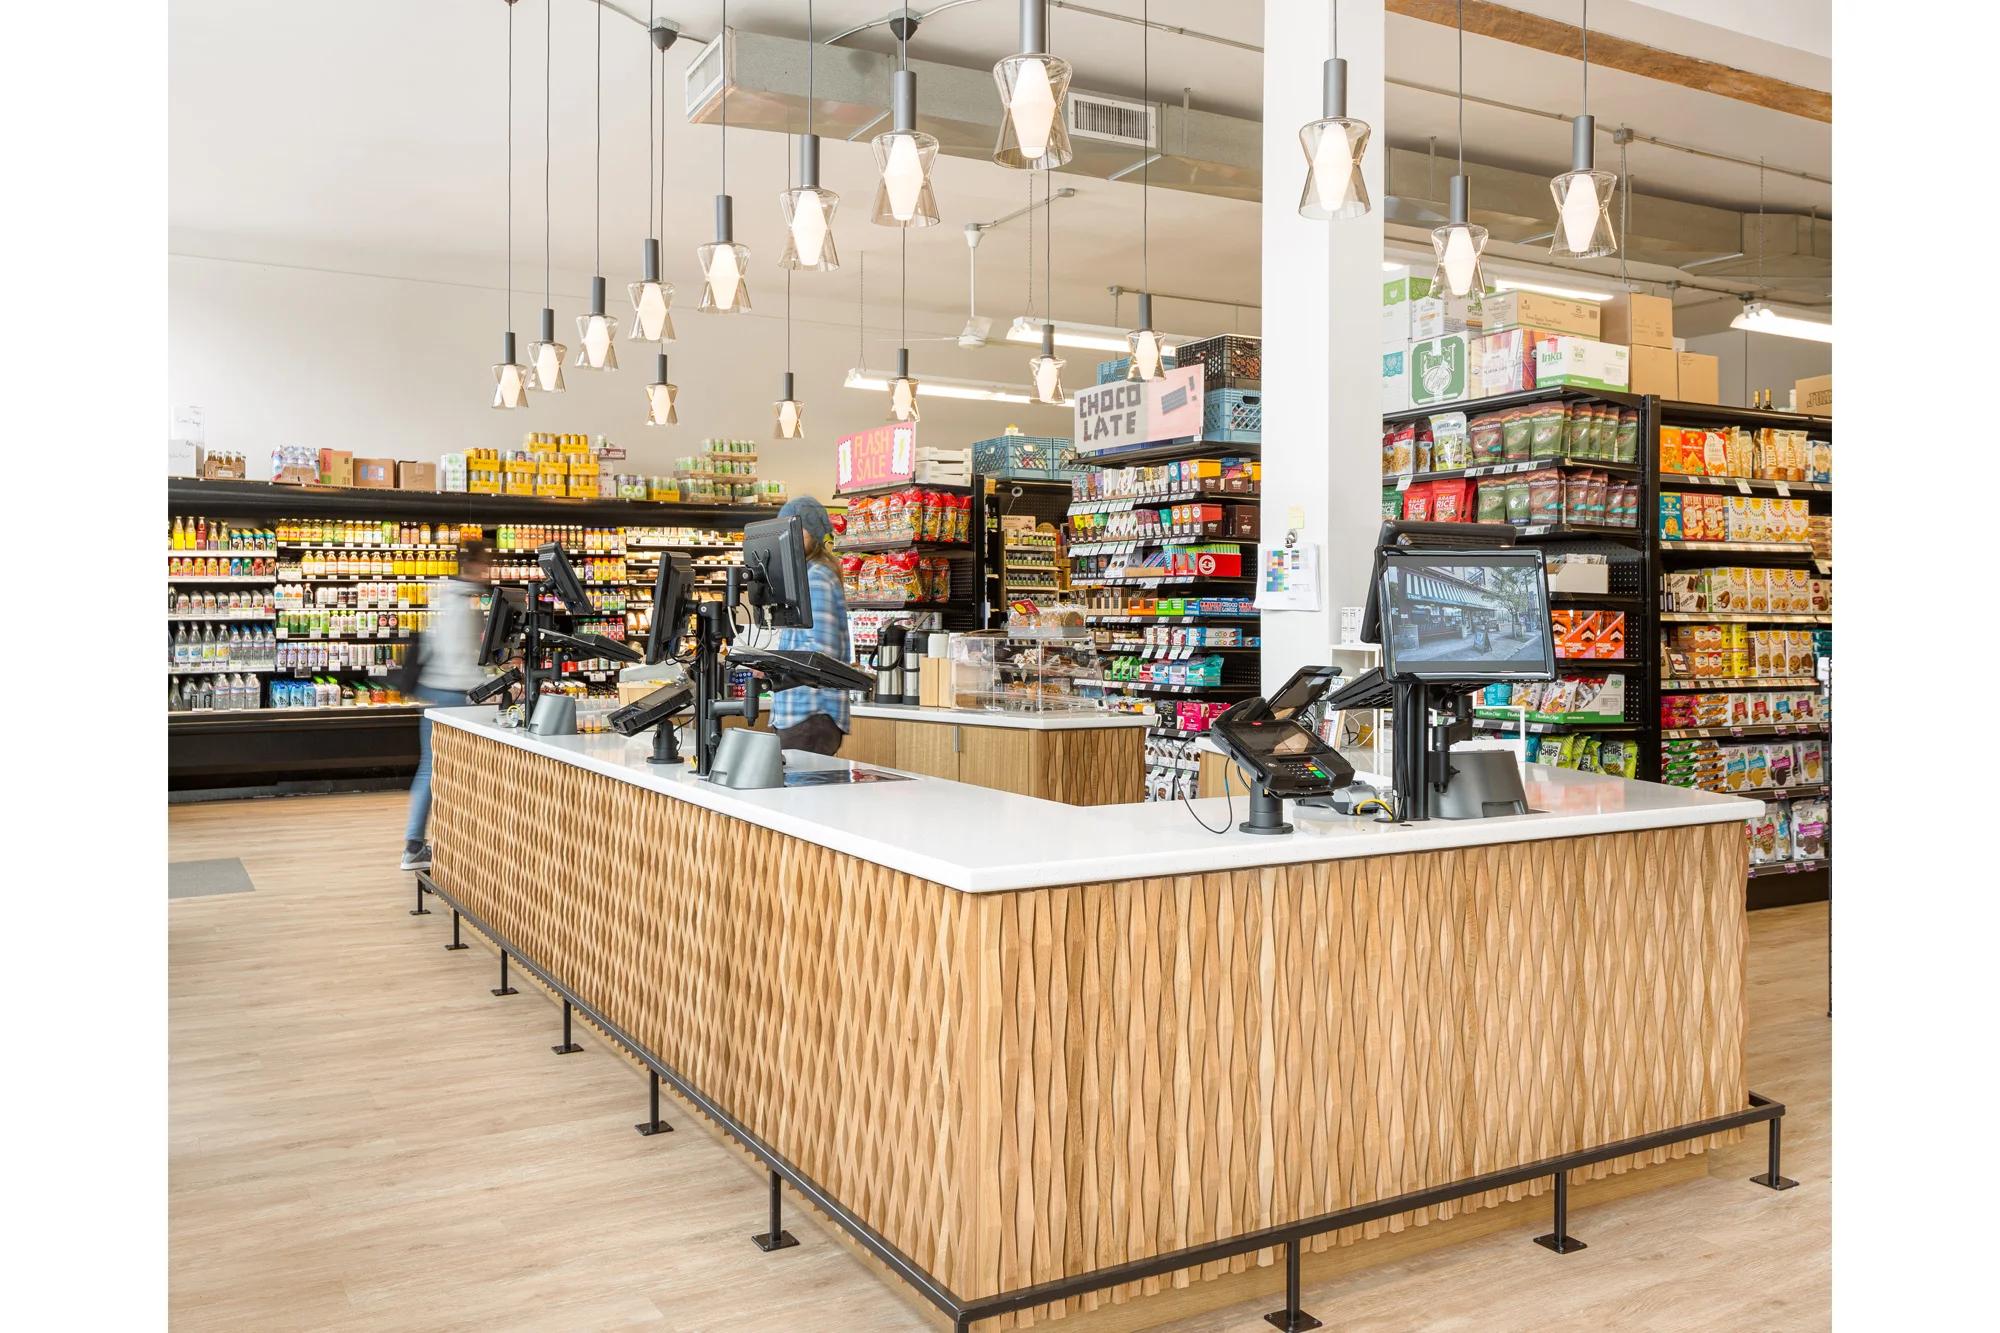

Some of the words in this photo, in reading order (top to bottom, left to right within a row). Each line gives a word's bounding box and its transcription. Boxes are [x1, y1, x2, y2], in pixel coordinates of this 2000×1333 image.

[1079, 384, 1142, 418] CHOCO
[1083, 411, 1137, 442] LATE
[854, 429, 889, 459] FLASH
[856, 454, 886, 481] SALE
[1436, 501, 1455, 509] RICE
[1541, 748, 1558, 757] CHIPS
[1604, 748, 1622, 757] CHIPS
